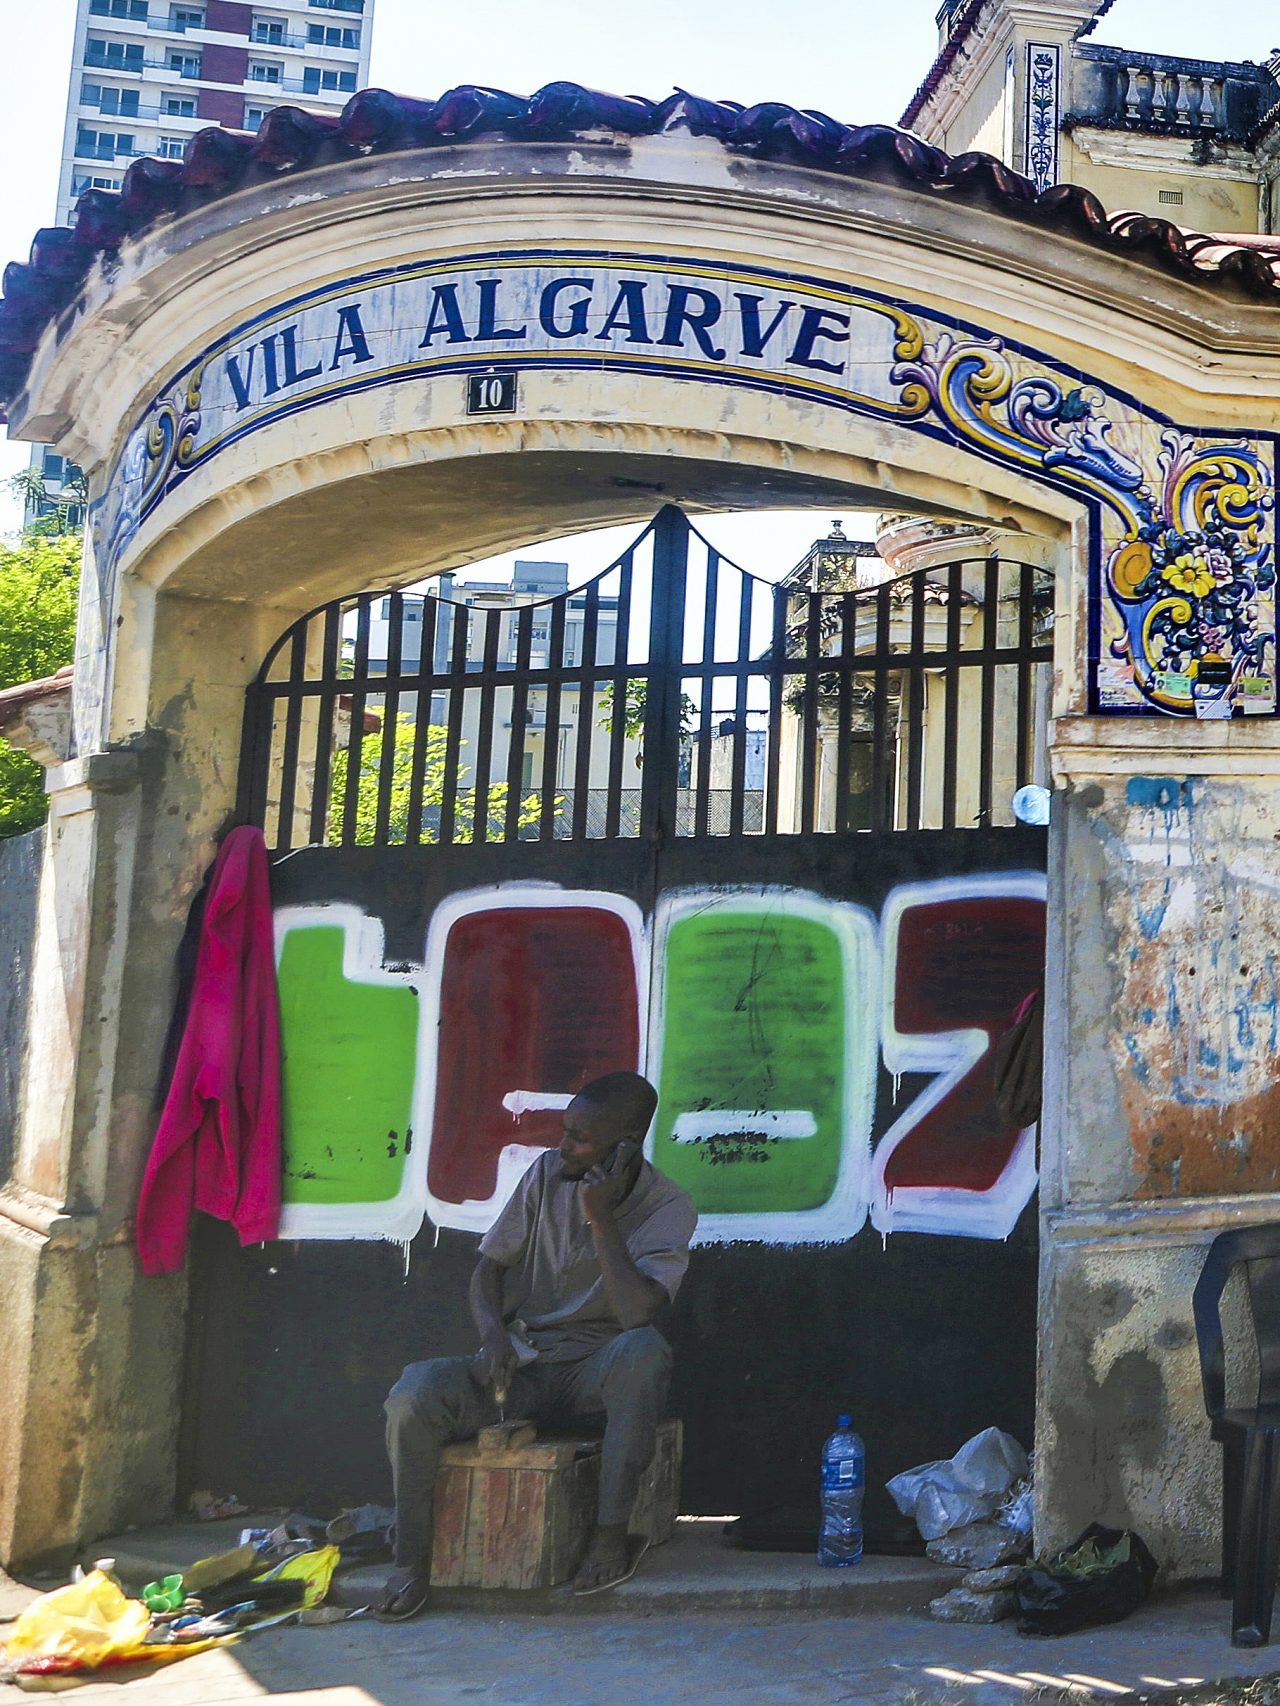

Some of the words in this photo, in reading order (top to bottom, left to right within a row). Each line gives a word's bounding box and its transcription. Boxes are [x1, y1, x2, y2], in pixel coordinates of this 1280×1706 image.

[226, 303, 375, 412] VILA
[418, 278, 852, 375] ALGARVE
[478, 379, 503, 408] 10
